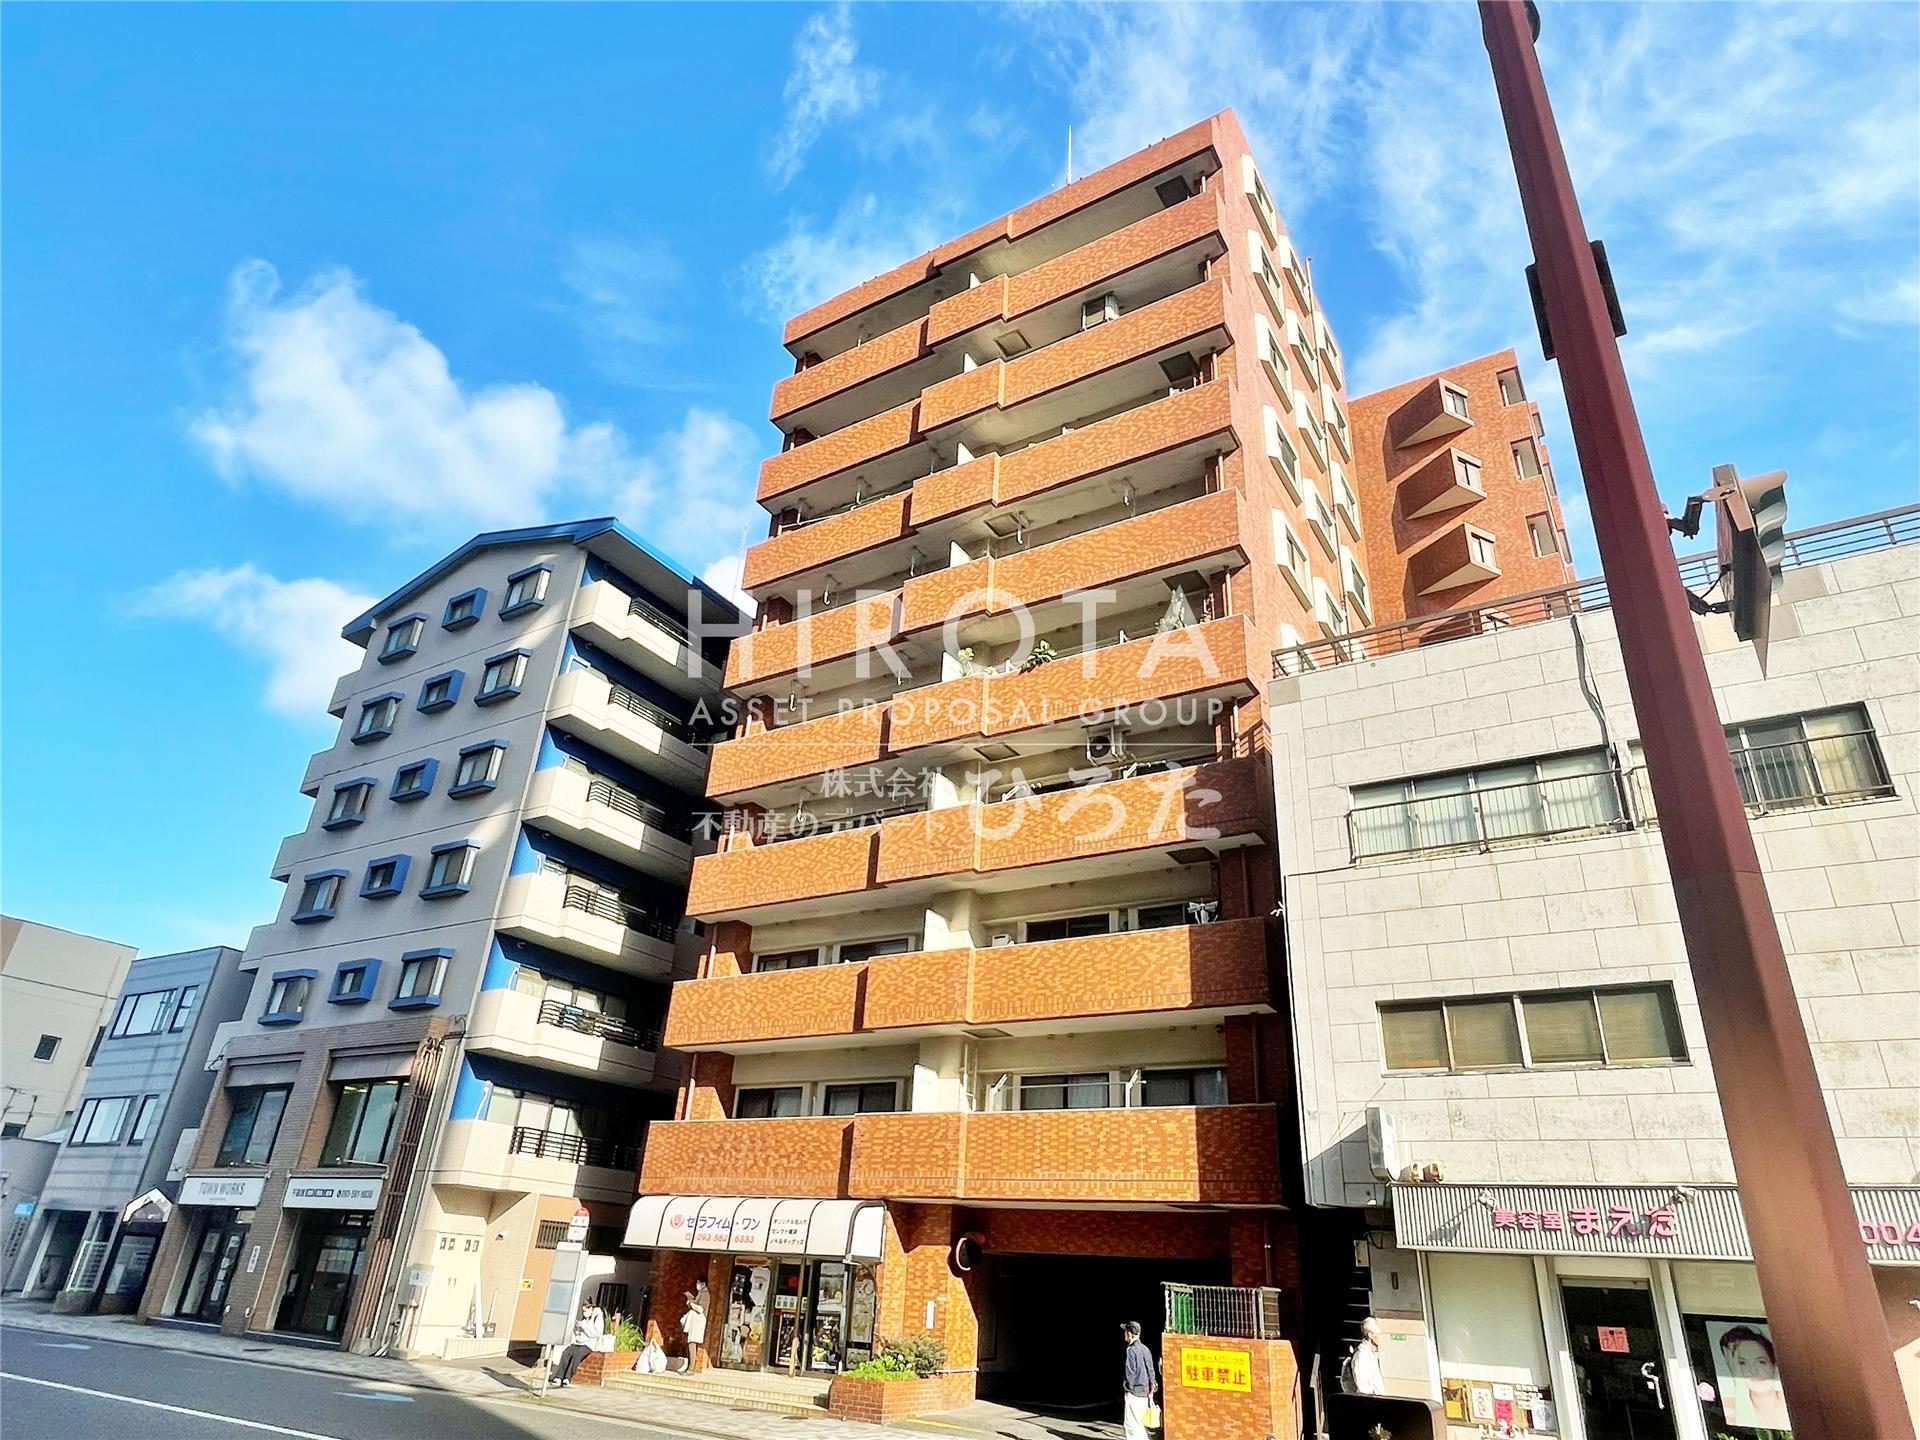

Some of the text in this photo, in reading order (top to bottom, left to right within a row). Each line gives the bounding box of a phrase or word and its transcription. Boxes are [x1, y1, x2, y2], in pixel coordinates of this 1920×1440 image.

[219, 1182, 246, 1195] WORKS
[686, 1215, 760, 1231] セラフィム・ワン
[1492, 1209, 1562, 1231] 美容室
[1185, 1365, 1247, 1385] 駐車禁止
